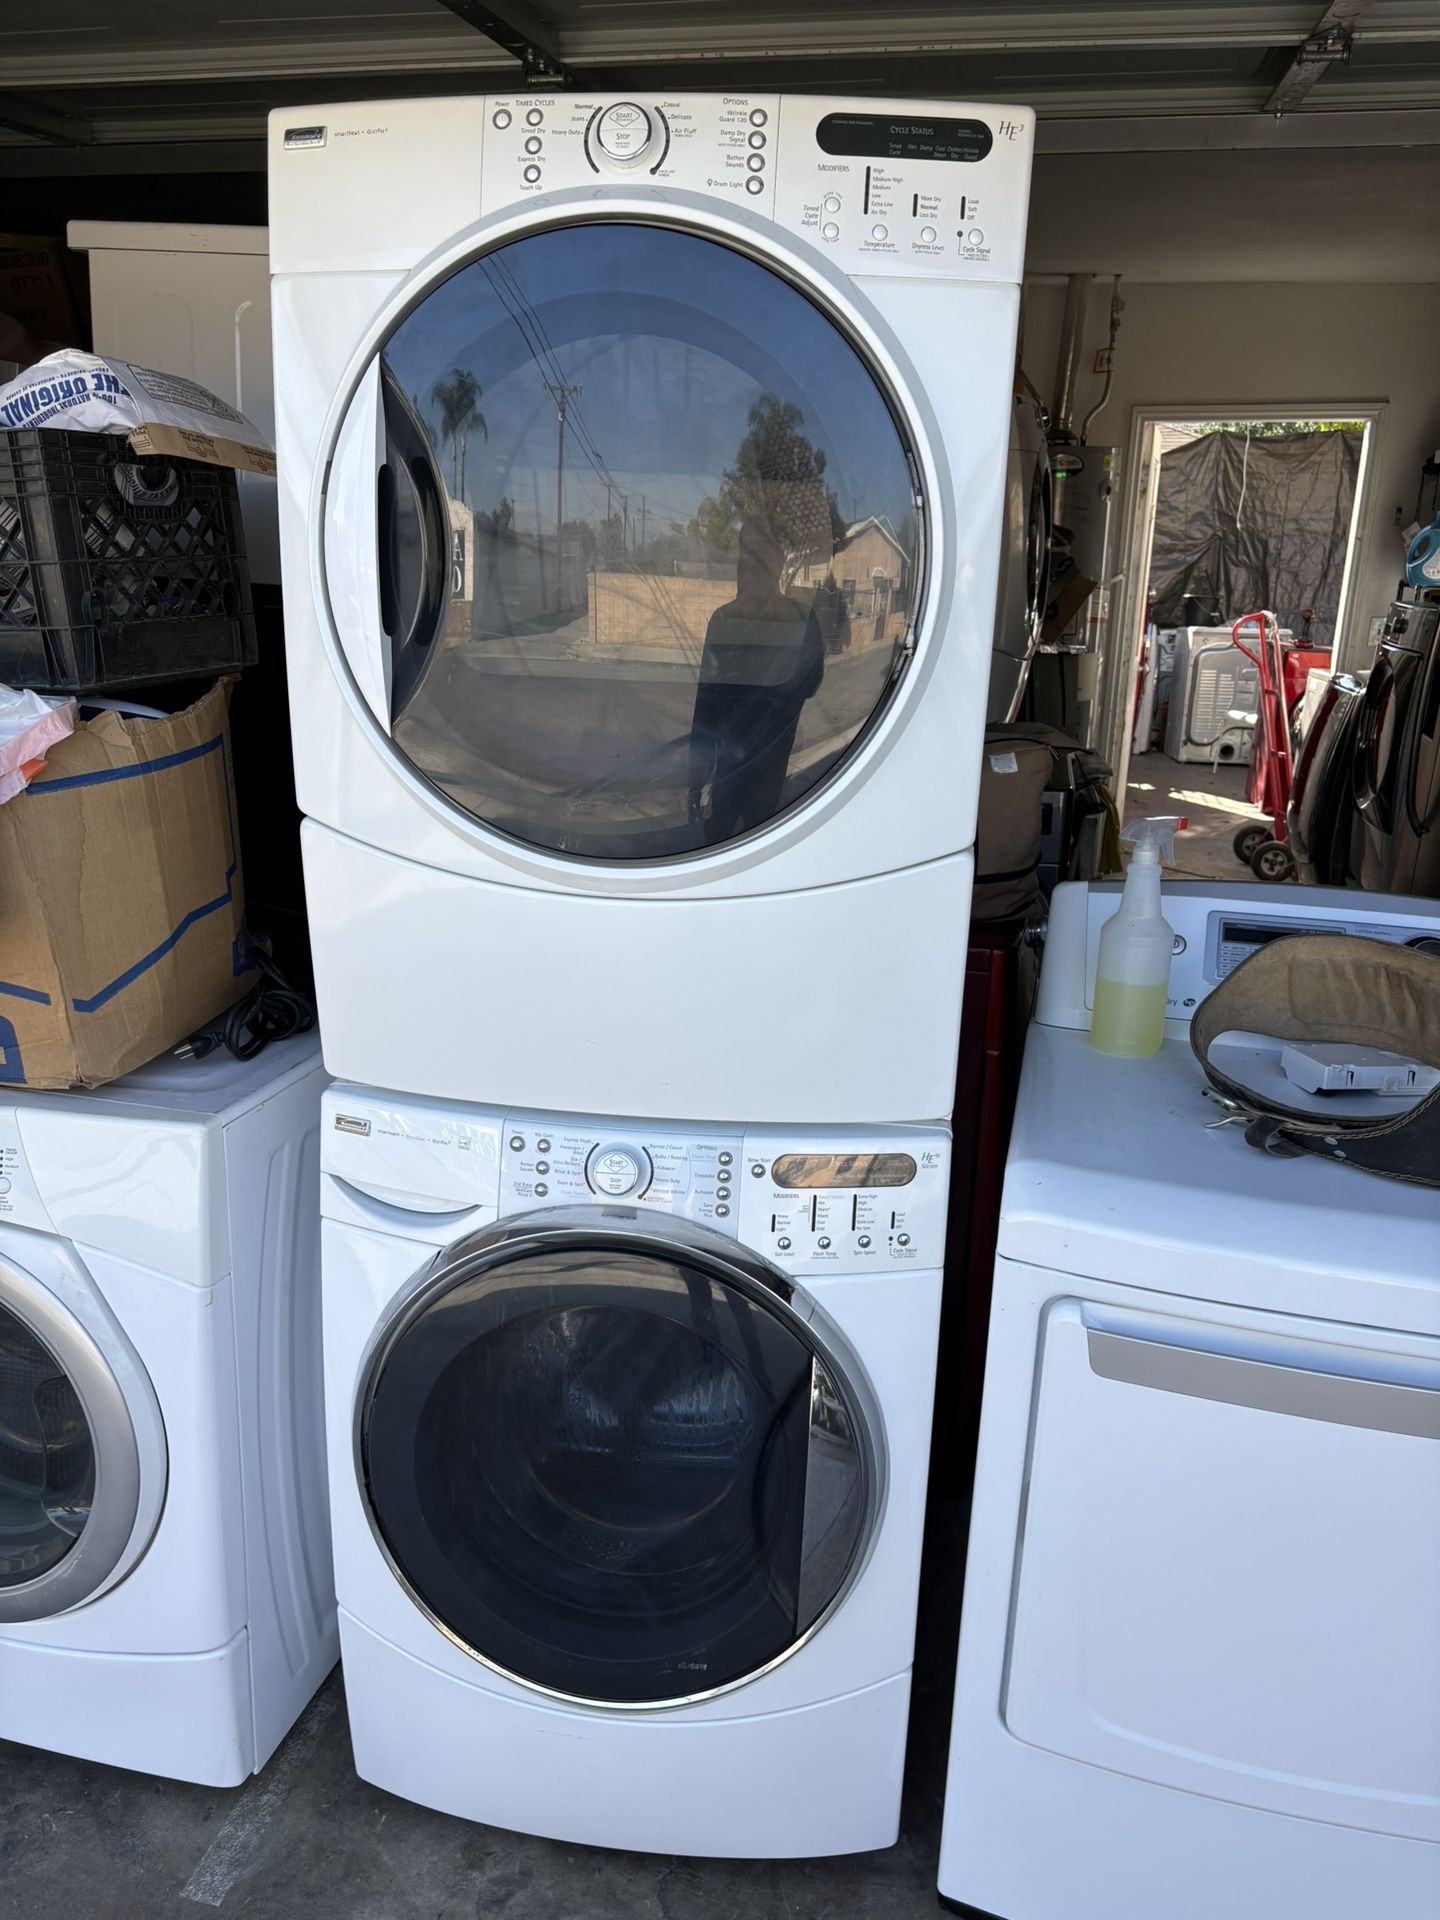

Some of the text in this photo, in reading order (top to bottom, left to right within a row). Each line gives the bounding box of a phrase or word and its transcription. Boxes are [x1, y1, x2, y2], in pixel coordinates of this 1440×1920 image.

[722, 97, 749, 106] OPTIONS
[890, 125, 934, 135] CYCLE STATUS
[818, 164, 850, 172] MODIFIERS
[801, 219, 818, 227] Adjust
[864, 241, 895, 249] Temperature
[912, 243, 931, 251] Dryness
[1, 376, 88, 427] ORIGINAL
[22, 391, 117, 429] 100% NATURAL INGREDIENTS
